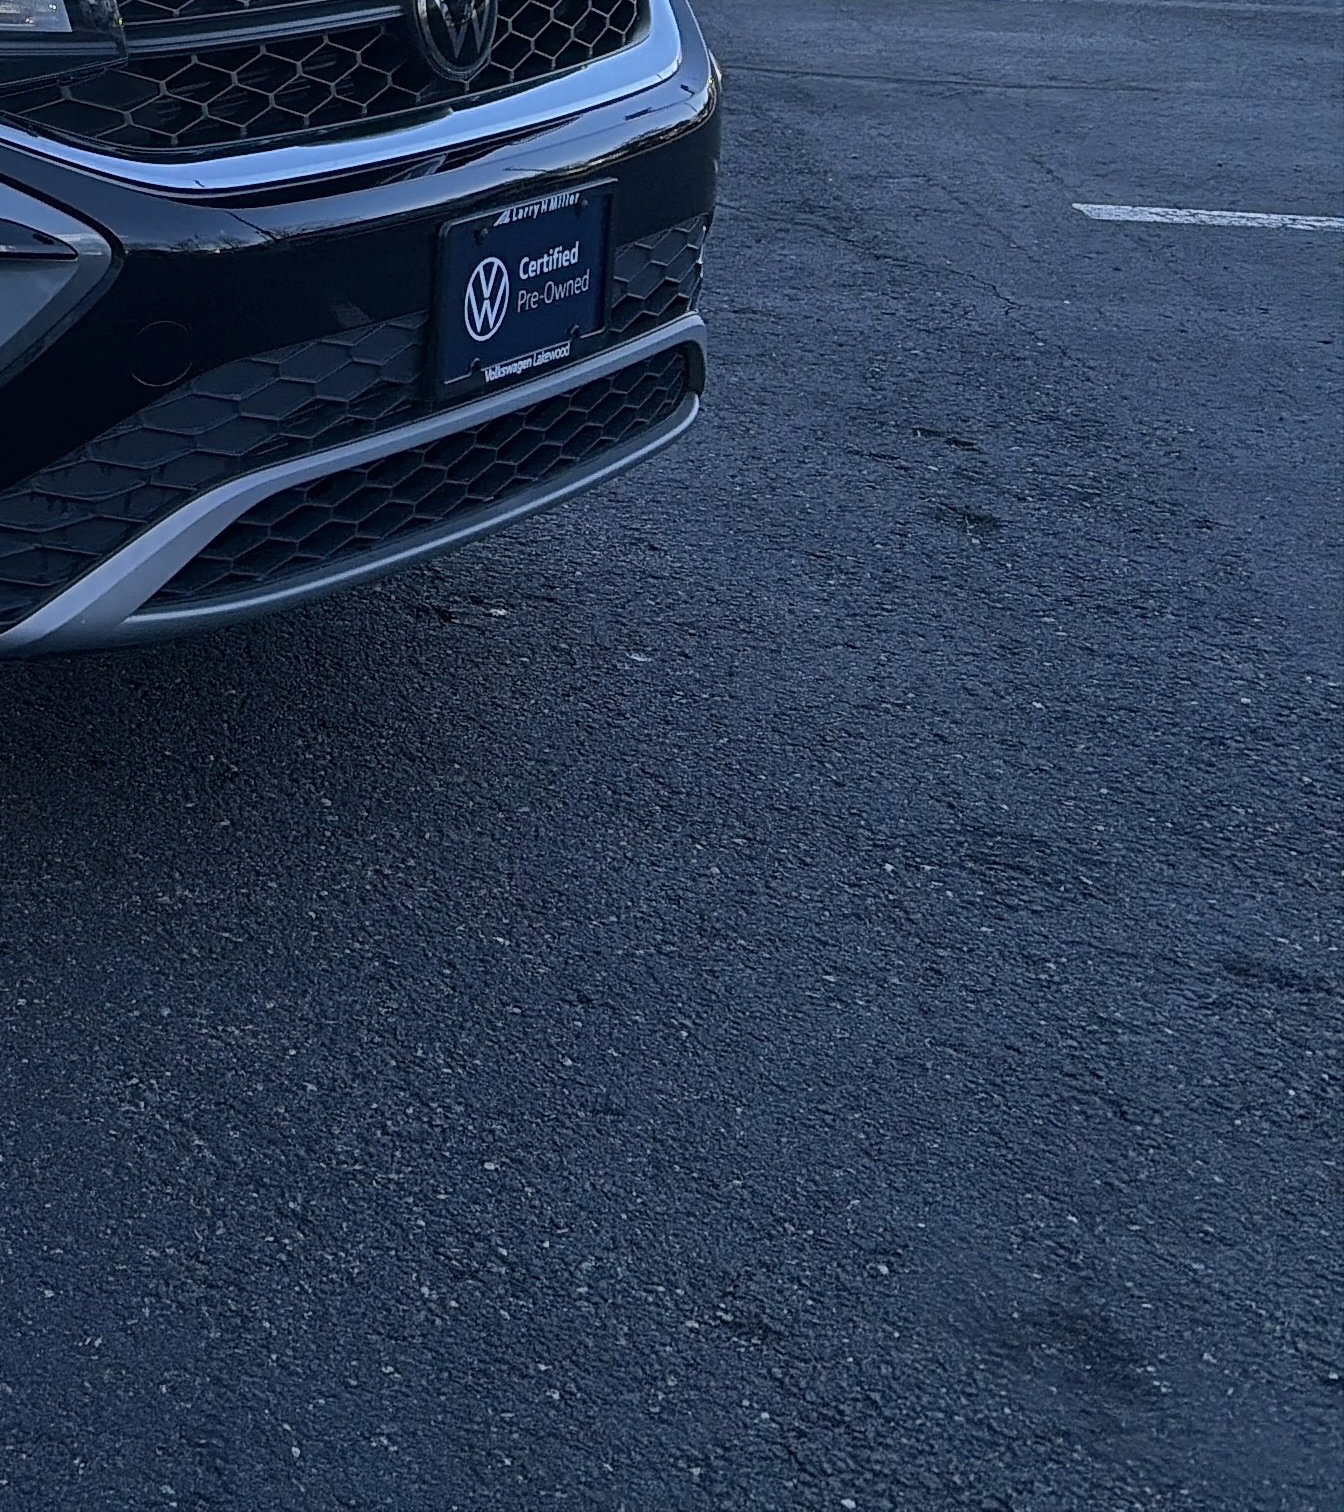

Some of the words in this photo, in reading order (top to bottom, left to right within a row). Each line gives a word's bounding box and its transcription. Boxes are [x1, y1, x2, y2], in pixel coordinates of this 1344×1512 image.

[512, 202, 539, 222] Larry
[549, 193, 580, 212] Miller
[519, 241, 580, 280] Certified
[517, 269, 590, 313] Pre-Owned
[484, 356, 532, 383] Volkswagen
[533, 342, 571, 367] Lakewood
